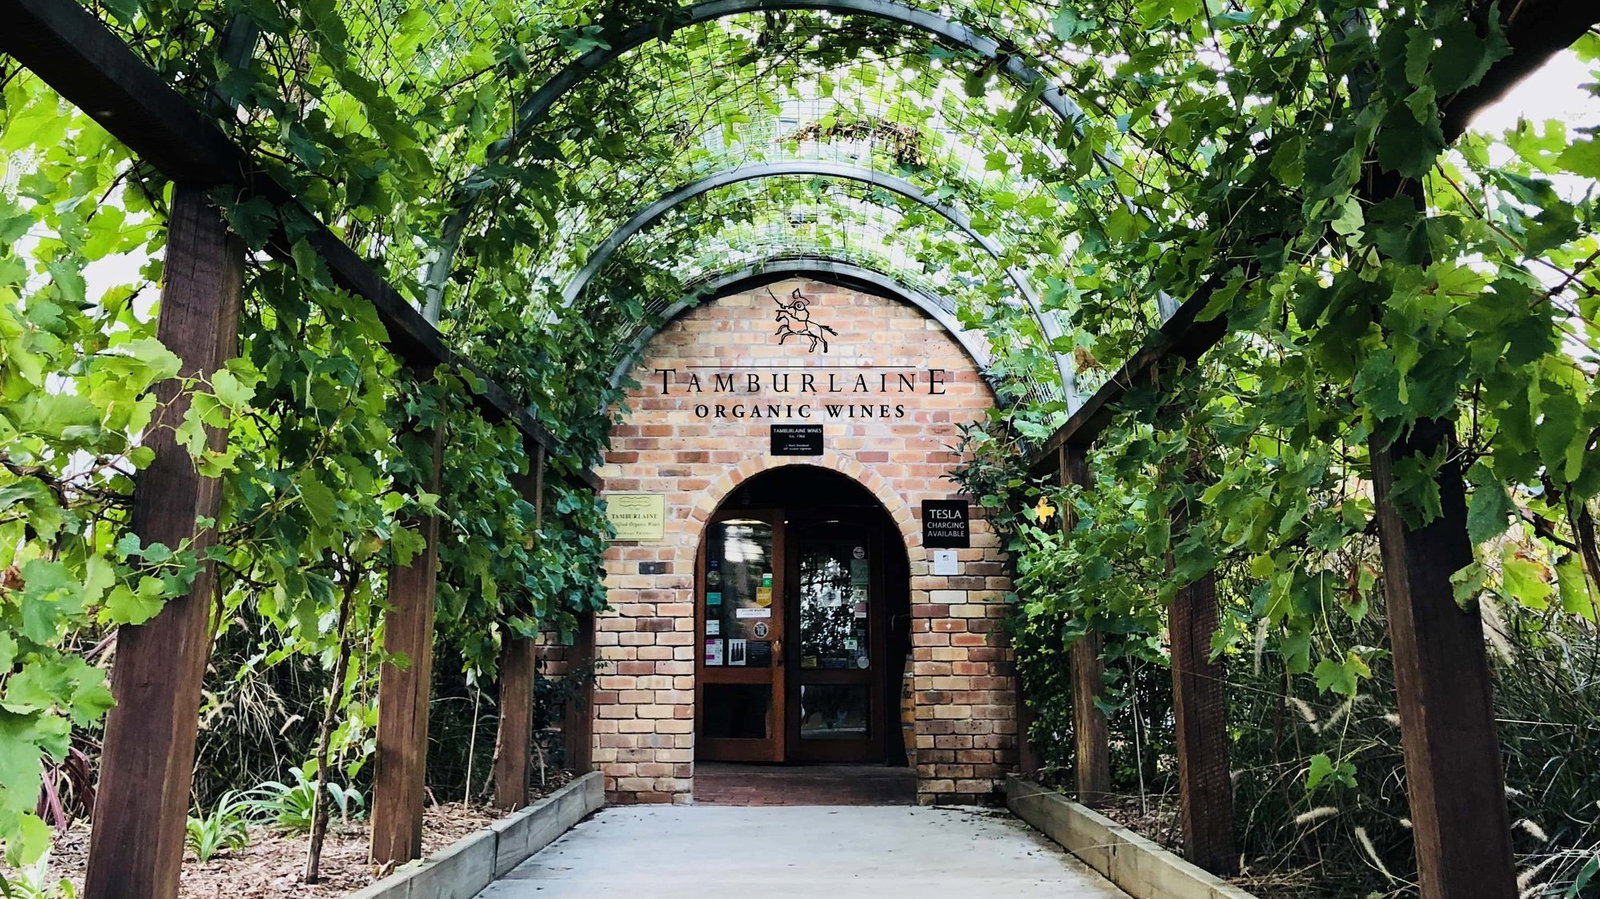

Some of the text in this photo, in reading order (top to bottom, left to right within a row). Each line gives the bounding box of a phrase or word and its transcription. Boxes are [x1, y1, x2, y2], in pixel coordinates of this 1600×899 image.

[654, 368, 946, 395] TAMBURLAINE
[694, 403, 905, 419] ORGANIC WINES
[929, 509, 962, 519] TESLA
[927, 521, 965, 529] CHARGING
